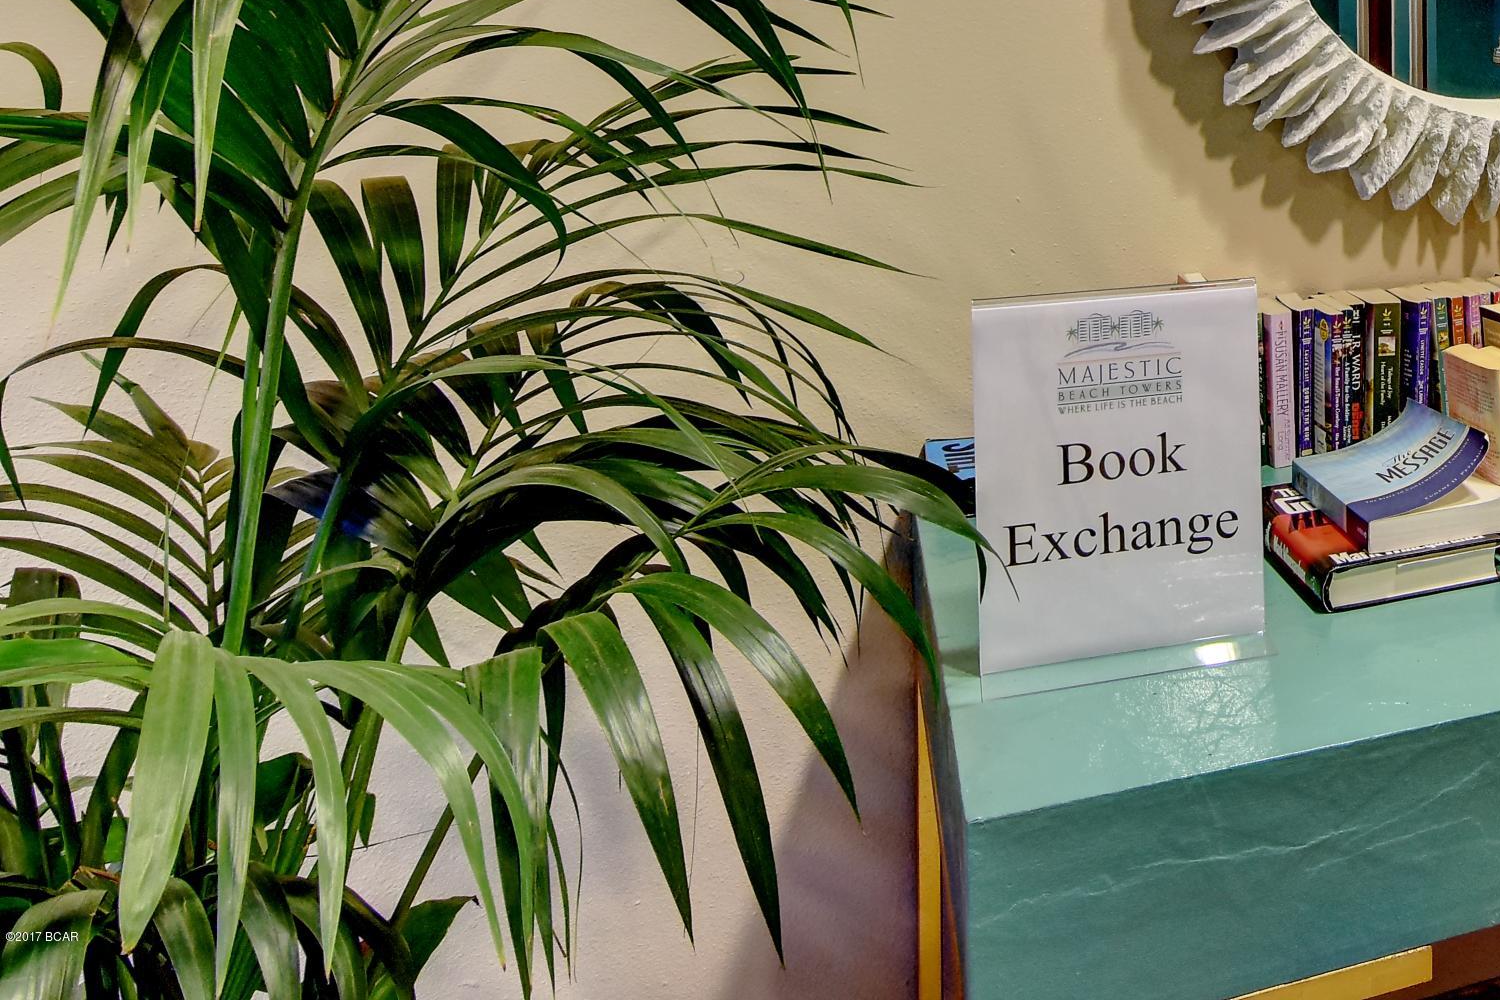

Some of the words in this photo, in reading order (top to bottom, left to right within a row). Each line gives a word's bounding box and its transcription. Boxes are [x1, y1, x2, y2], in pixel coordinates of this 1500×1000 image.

[1058, 356, 1182, 386] MAJESTIC
[1273, 339, 1287, 372] SUSAN
[1351, 353, 1361, 391] WARD
[1058, 387, 1110, 401] BEACH
[1120, 380, 1182, 395] TOWERS
[1058, 403, 1092, 415] WHERE
[1095, 401, 1114, 411] LIFE
[1117, 400, 1126, 409] IS
[1130, 398, 1148, 408] THE
[1151, 395, 1183, 405] BEACH
[1274, 374, 1289, 416] MALLERY
[1057, 432, 1187, 486] Book
[1376, 427, 1455, 483] MESSAGE
[1003, 510, 1239, 566] Exchange
